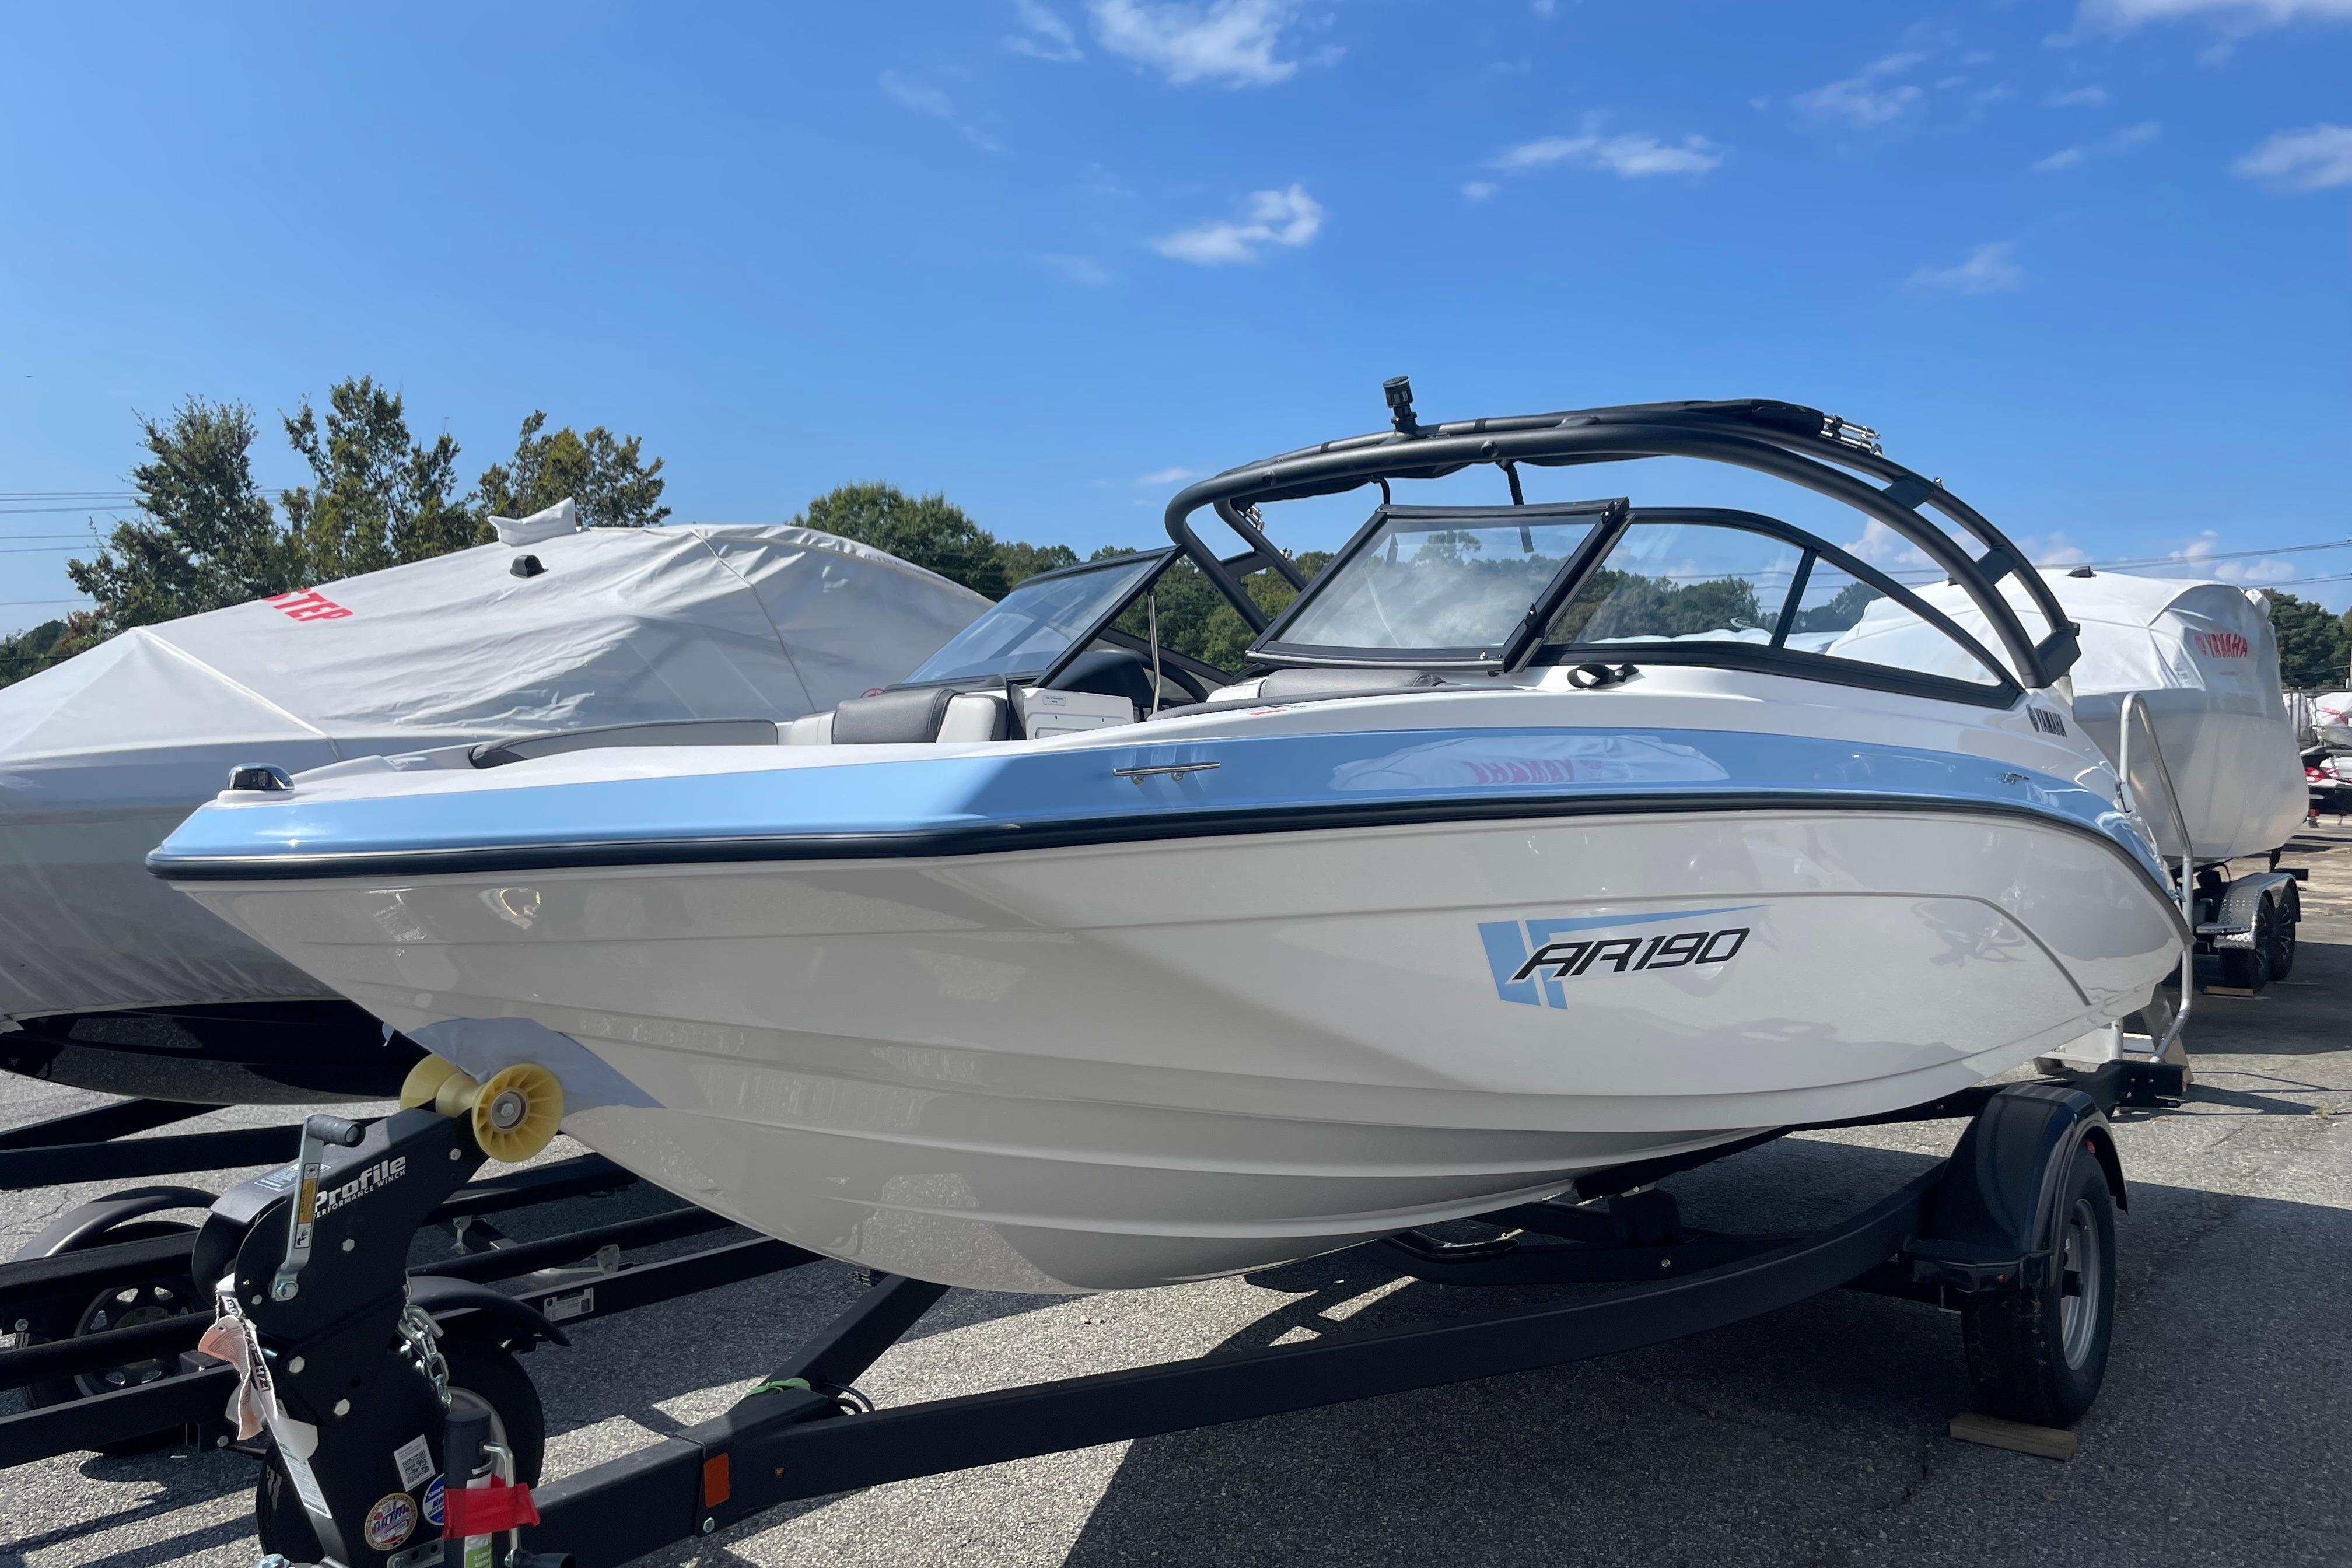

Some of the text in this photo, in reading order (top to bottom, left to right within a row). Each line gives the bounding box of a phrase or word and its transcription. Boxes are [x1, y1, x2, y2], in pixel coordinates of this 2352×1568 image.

[2204, 634, 2248, 658] YAMAHA
[2034, 707, 2067, 738] YAMAHA
[1512, 928, 1750, 980] AR190
[314, 1185, 374, 1218] ERFORMANCE
[377, 1170, 405, 1188] WINCH
[315, 1156, 406, 1212] Profile
